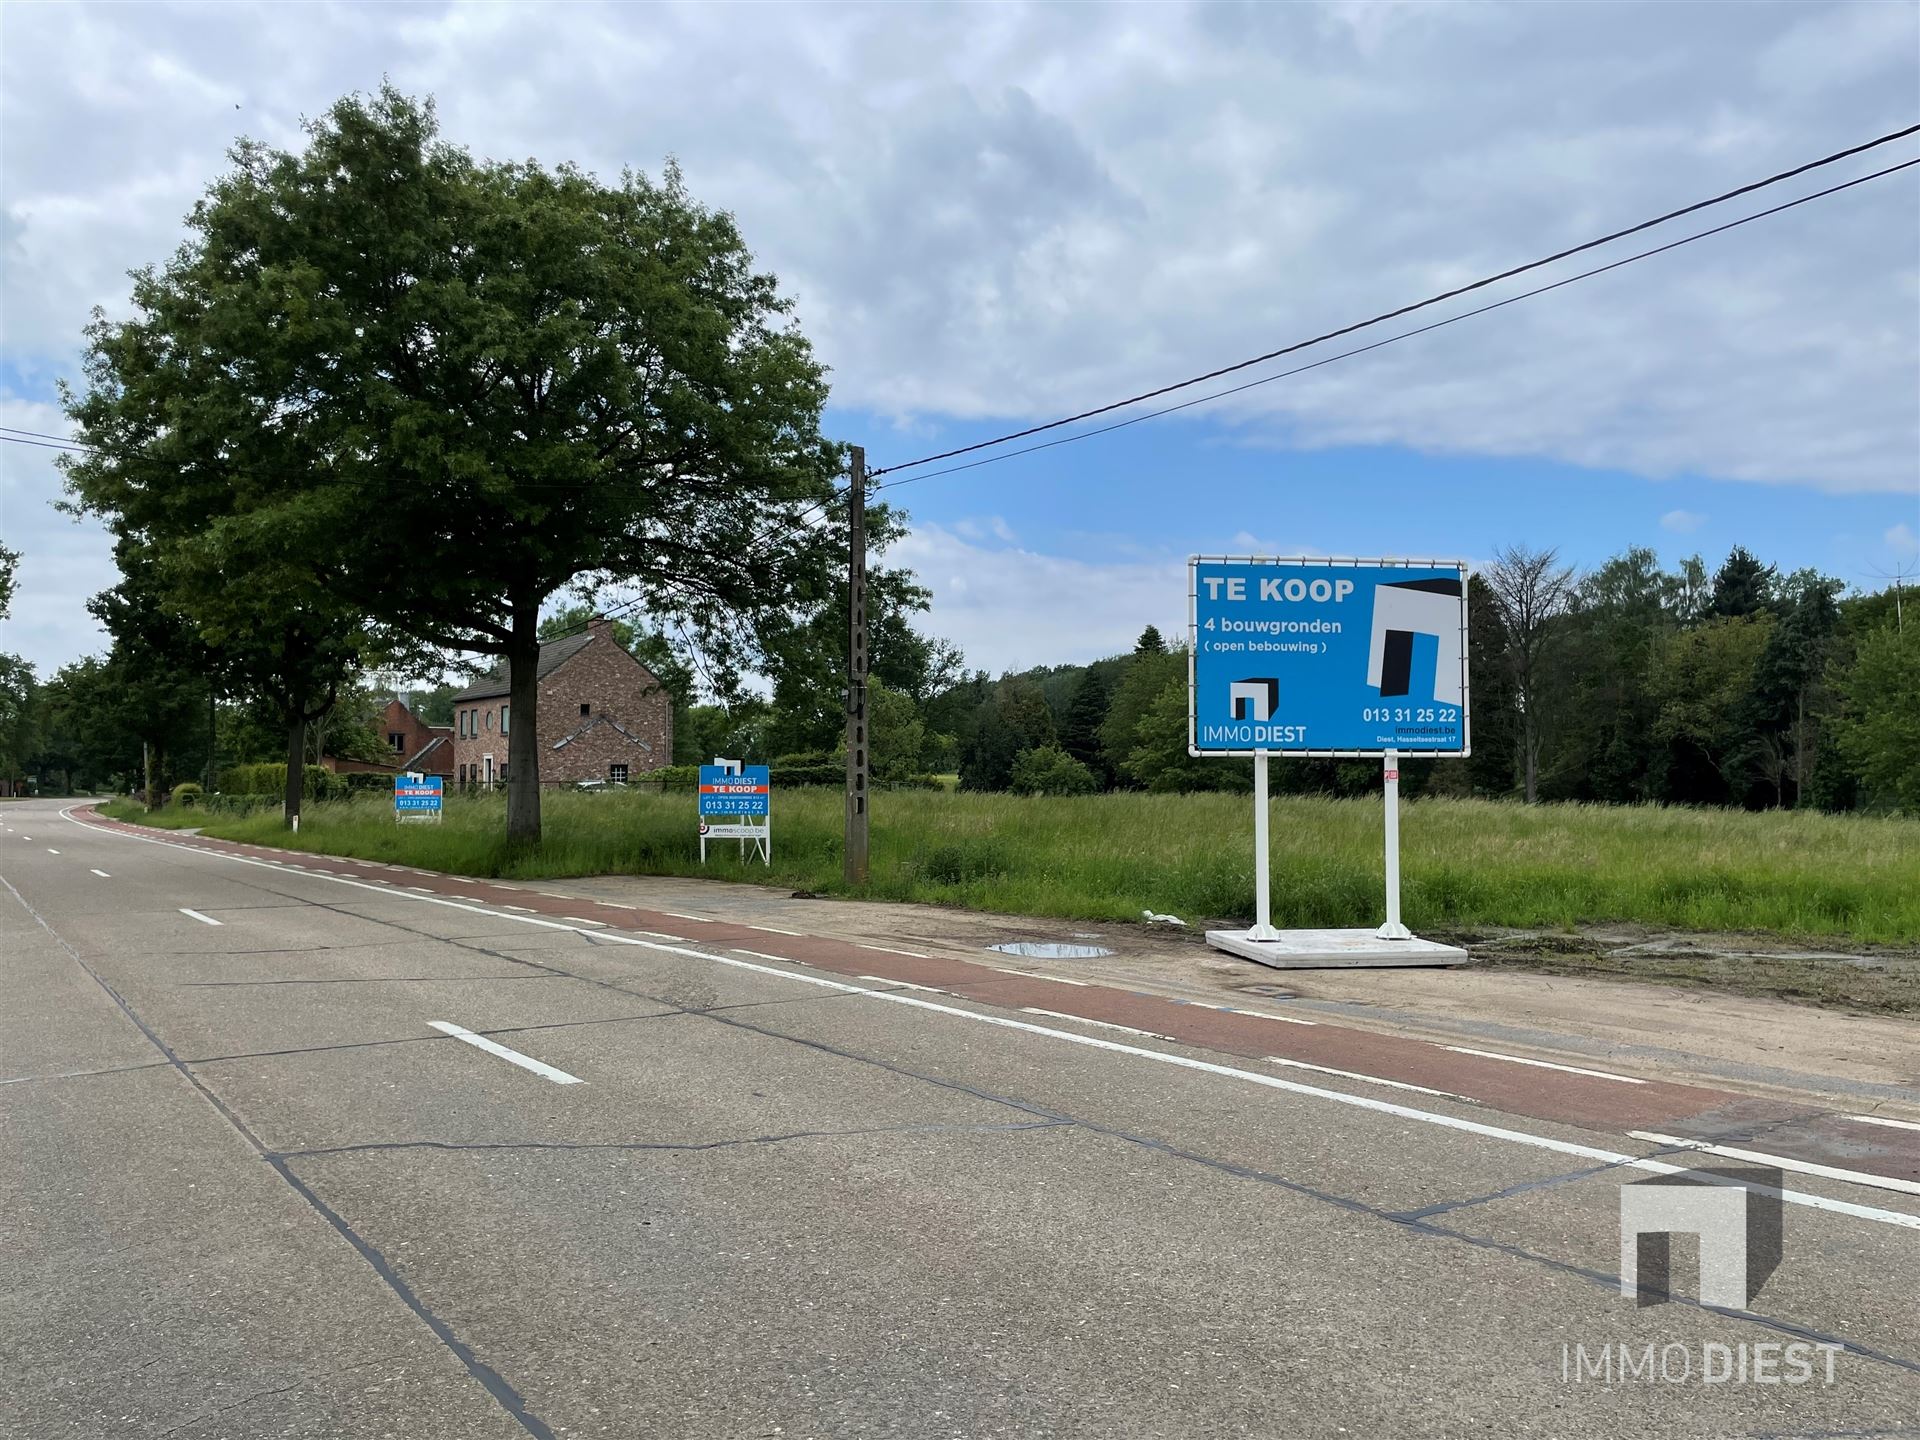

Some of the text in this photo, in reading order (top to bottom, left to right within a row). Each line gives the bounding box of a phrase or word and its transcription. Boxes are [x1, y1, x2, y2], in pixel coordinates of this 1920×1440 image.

[1203, 577, 1354, 603] TE KOOP
[1204, 617, 1342, 635] 4 bouwgronden
[1213, 642, 1245, 653] open
[1248, 640, 1318, 654] bebouwing
[1363, 708, 1456, 722] 013 31 25 22
[1255, 725, 1307, 742] DIEST
[1395, 726, 1456, 735] immodiest.be
[1376, 735, 1396, 743] Diest,
[712, 785, 758, 793] TE KOOP
[705, 801, 763, 810] 013 31 25 22
